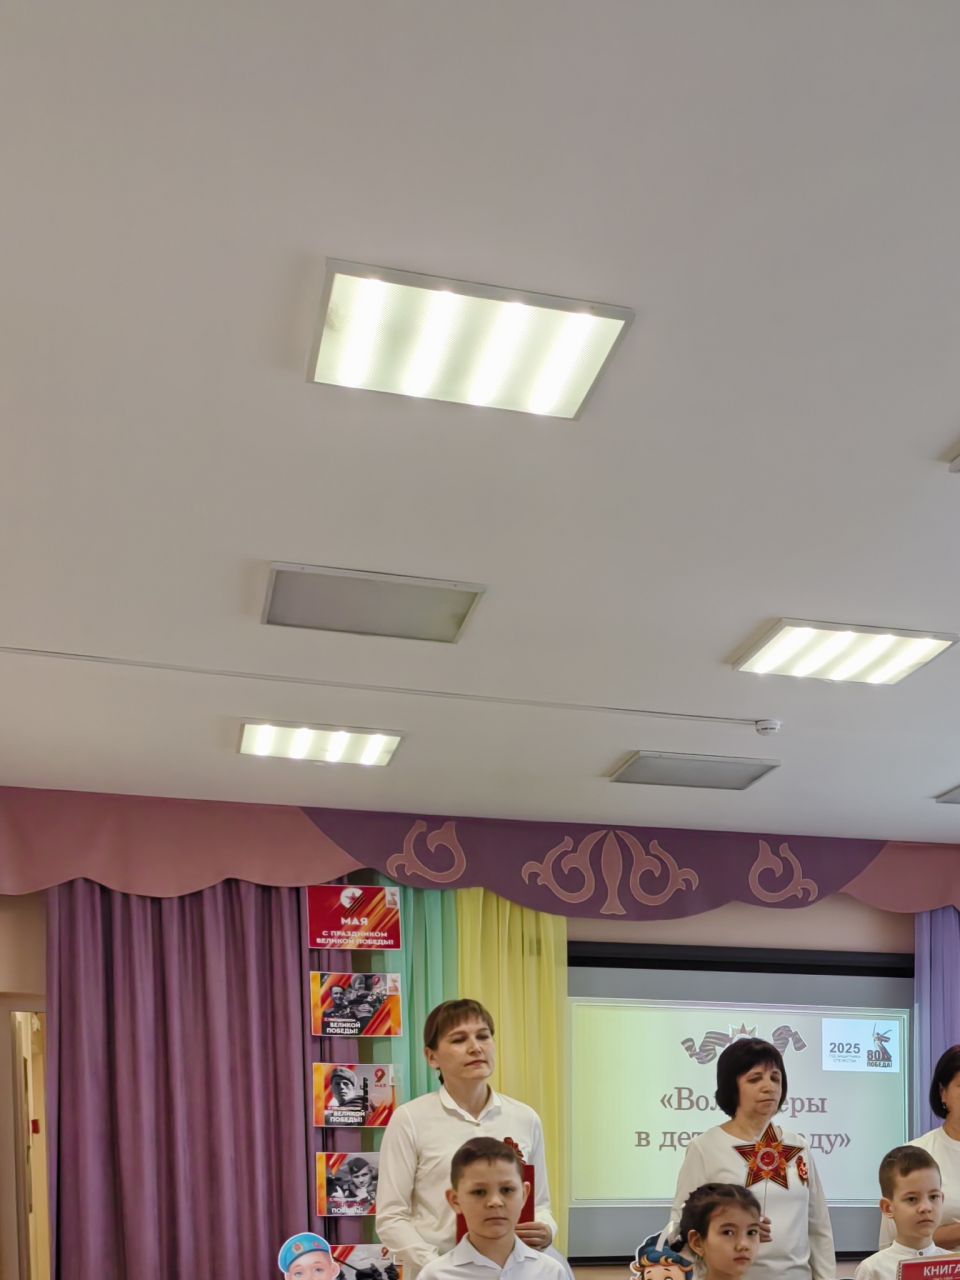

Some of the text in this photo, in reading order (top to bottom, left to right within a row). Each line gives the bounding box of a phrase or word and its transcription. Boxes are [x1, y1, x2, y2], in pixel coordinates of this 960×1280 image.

[341, 917, 368, 925] МАЯ
[829, 1042, 861, 1053] 2025
[867, 1050, 881, 1060] 80
[374, 1068, 385, 1083] 9
[635, 1131, 650, 1147] в
